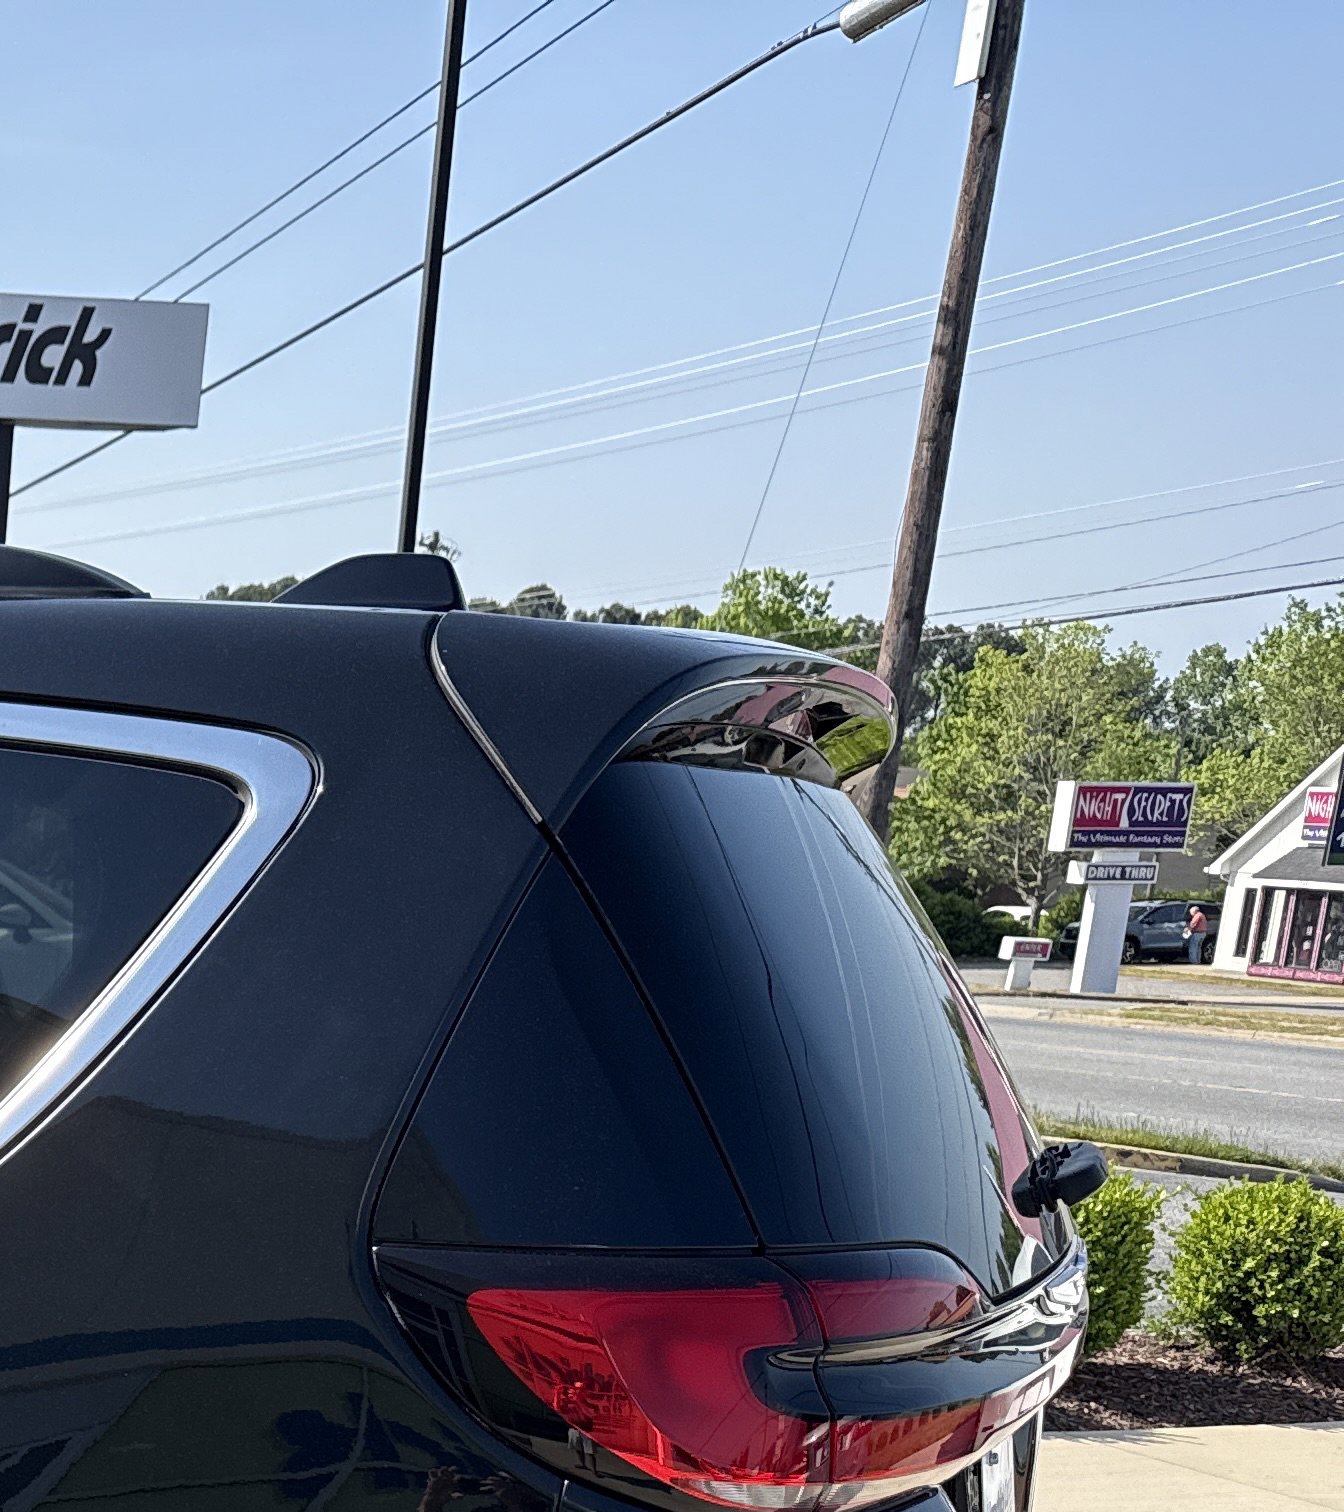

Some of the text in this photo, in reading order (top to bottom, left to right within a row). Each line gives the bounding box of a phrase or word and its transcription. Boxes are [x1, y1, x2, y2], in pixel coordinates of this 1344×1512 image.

[1132, 792, 1191, 822] SECRETS
[1073, 833, 1184, 845] The Ultimate Fantasy Store
[1087, 866, 1155, 880] DRIVE THRU
